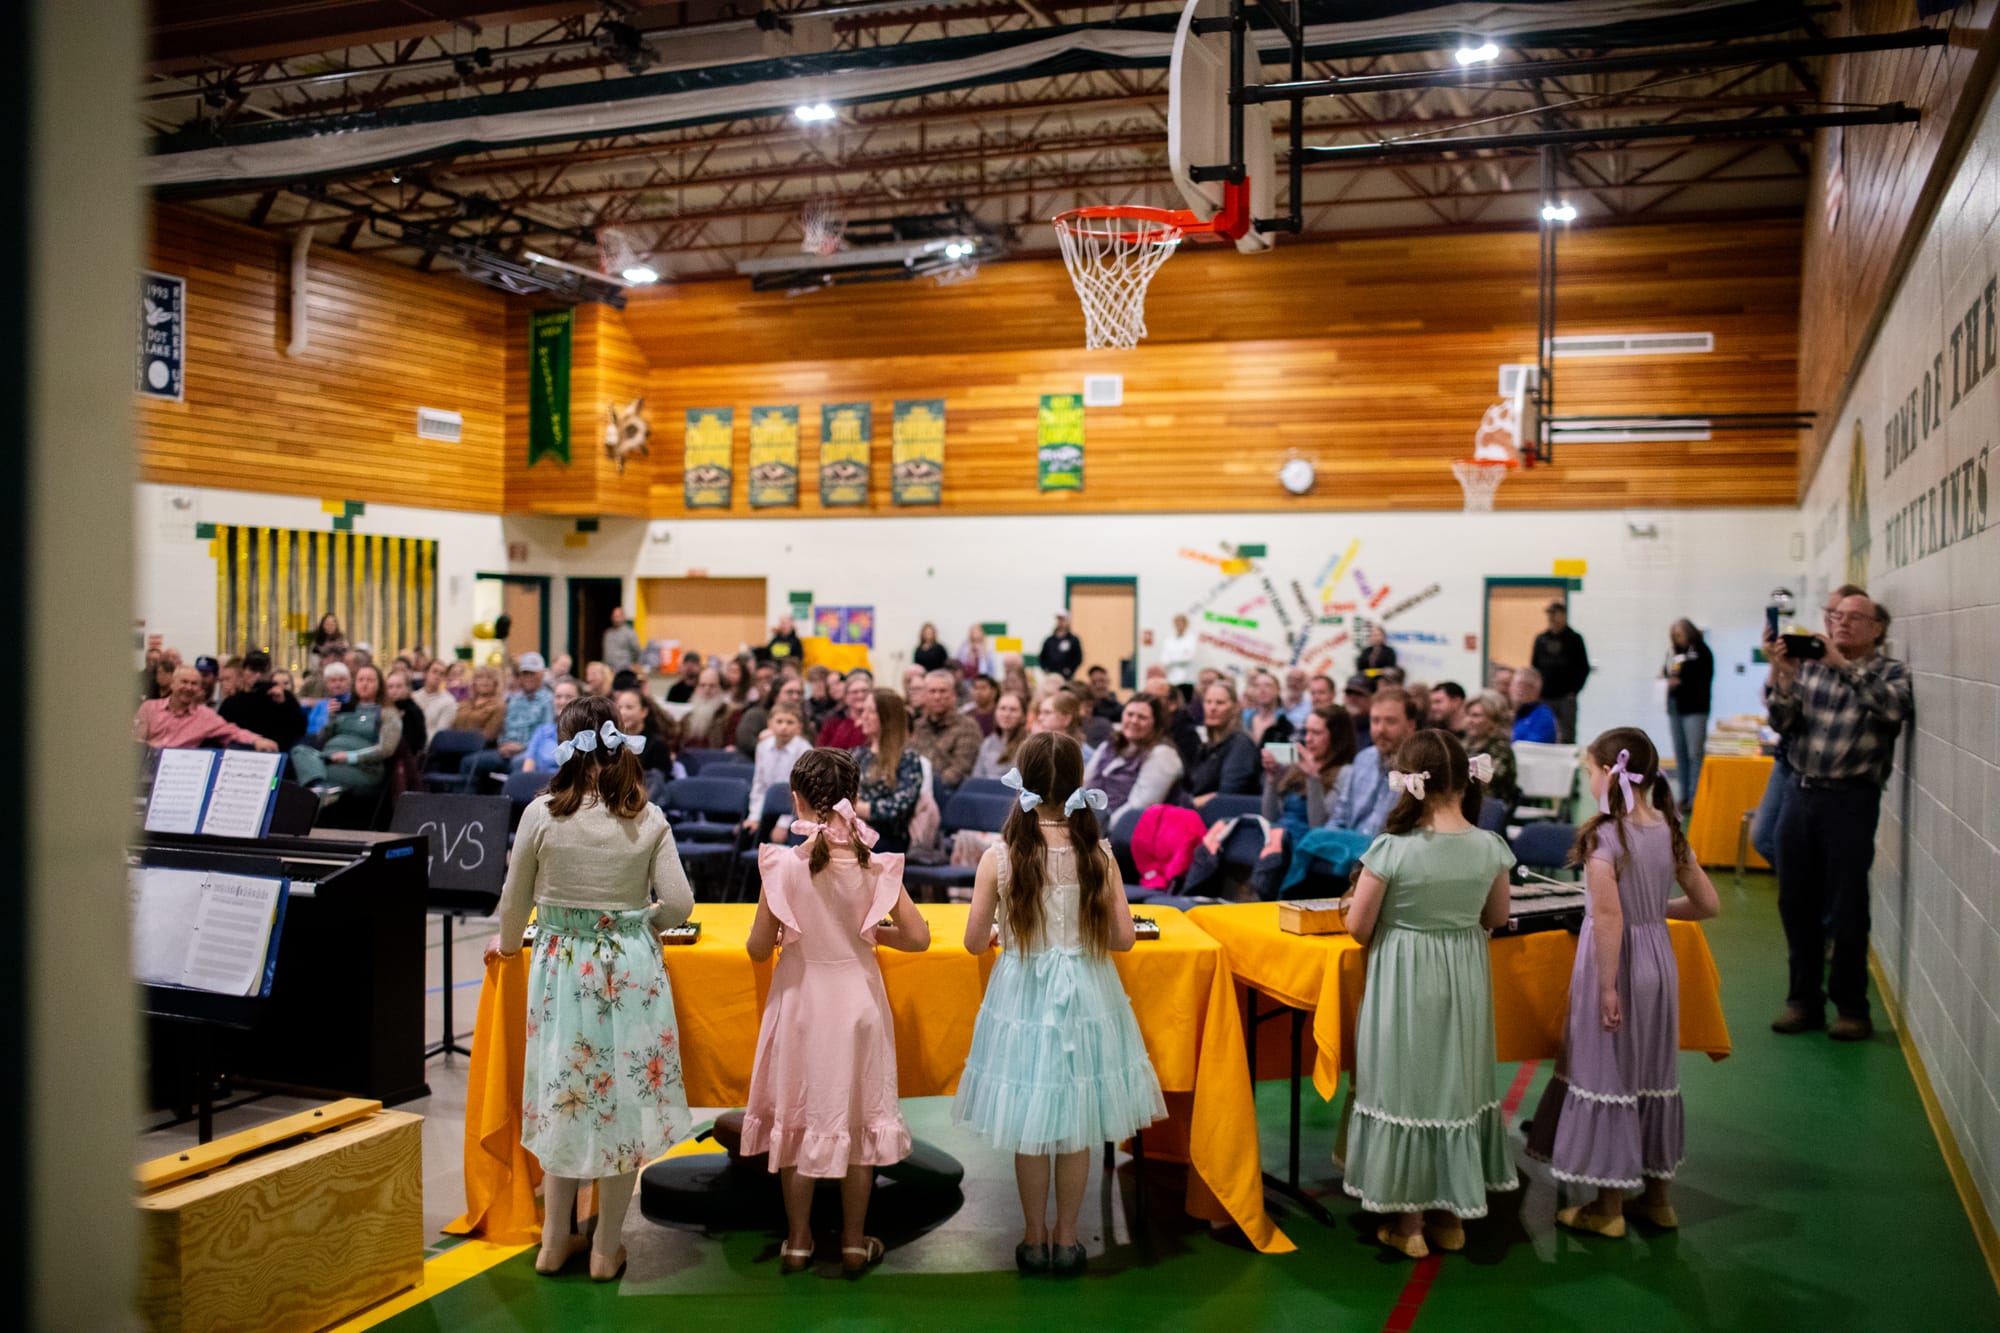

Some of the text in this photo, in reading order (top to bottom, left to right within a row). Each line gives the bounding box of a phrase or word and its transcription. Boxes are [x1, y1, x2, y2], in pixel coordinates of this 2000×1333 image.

[145, 341, 171, 358] LAKE
[147, 327, 168, 344] DOT
[1884, 271, 1998, 480] HOME OF THE
[1885, 440, 1989, 570] WOLVERINES
